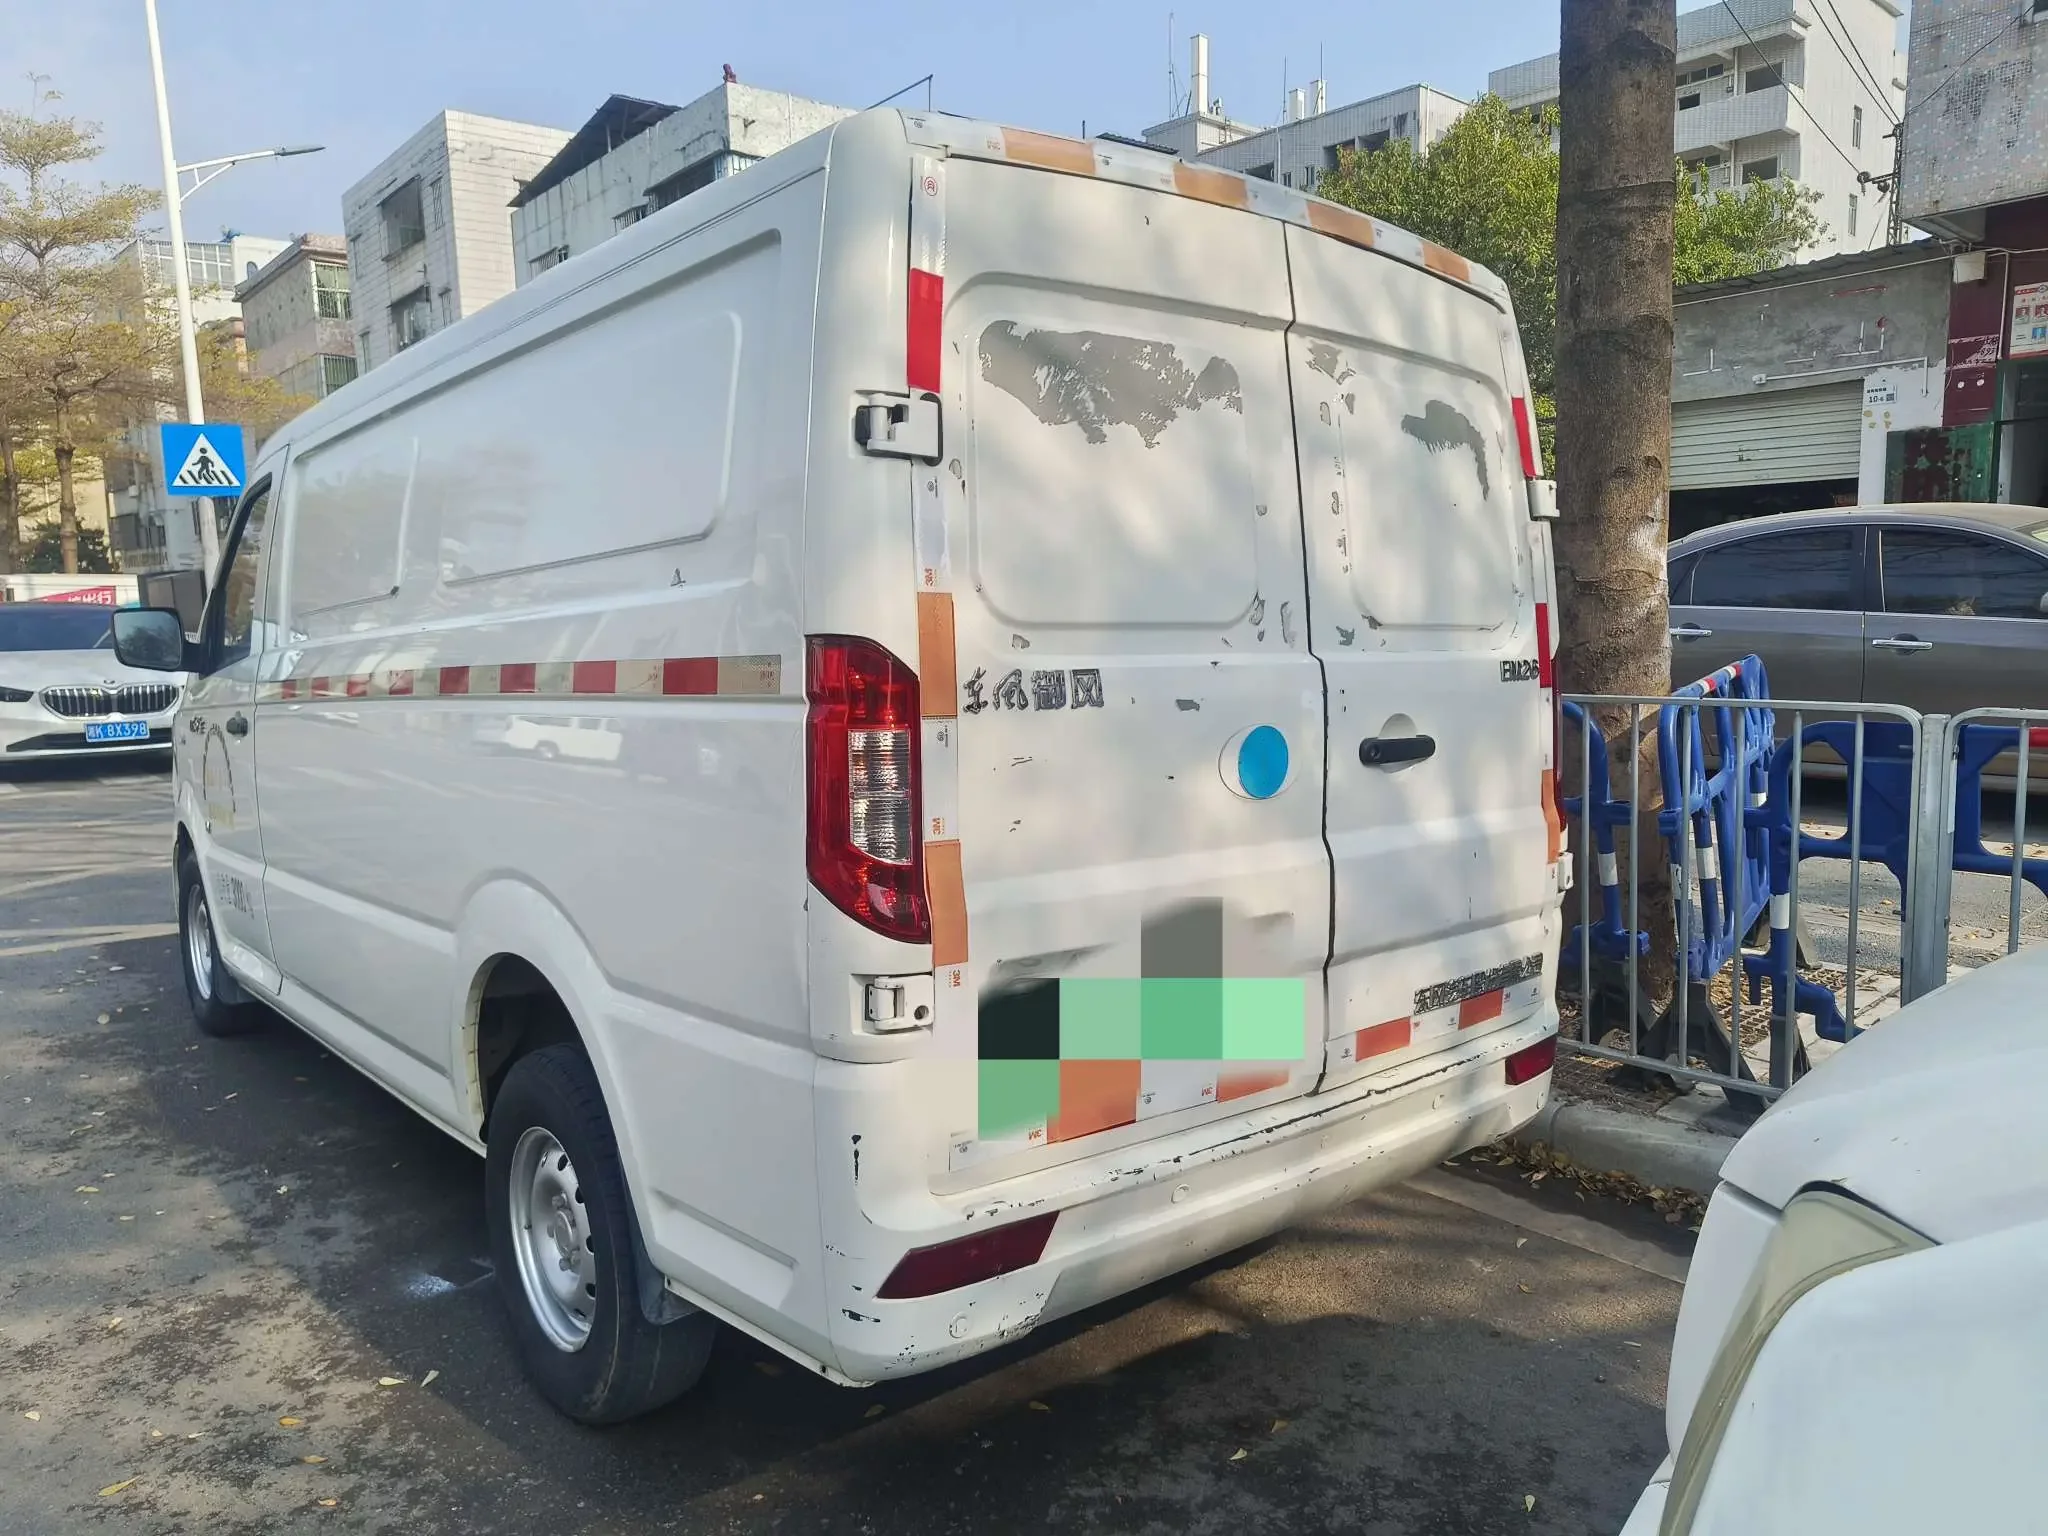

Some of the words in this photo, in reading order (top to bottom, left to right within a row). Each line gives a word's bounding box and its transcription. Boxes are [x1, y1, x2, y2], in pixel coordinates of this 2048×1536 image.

[963, 666, 1105, 715] 东风御风
[952, 969, 961, 987] 3M
